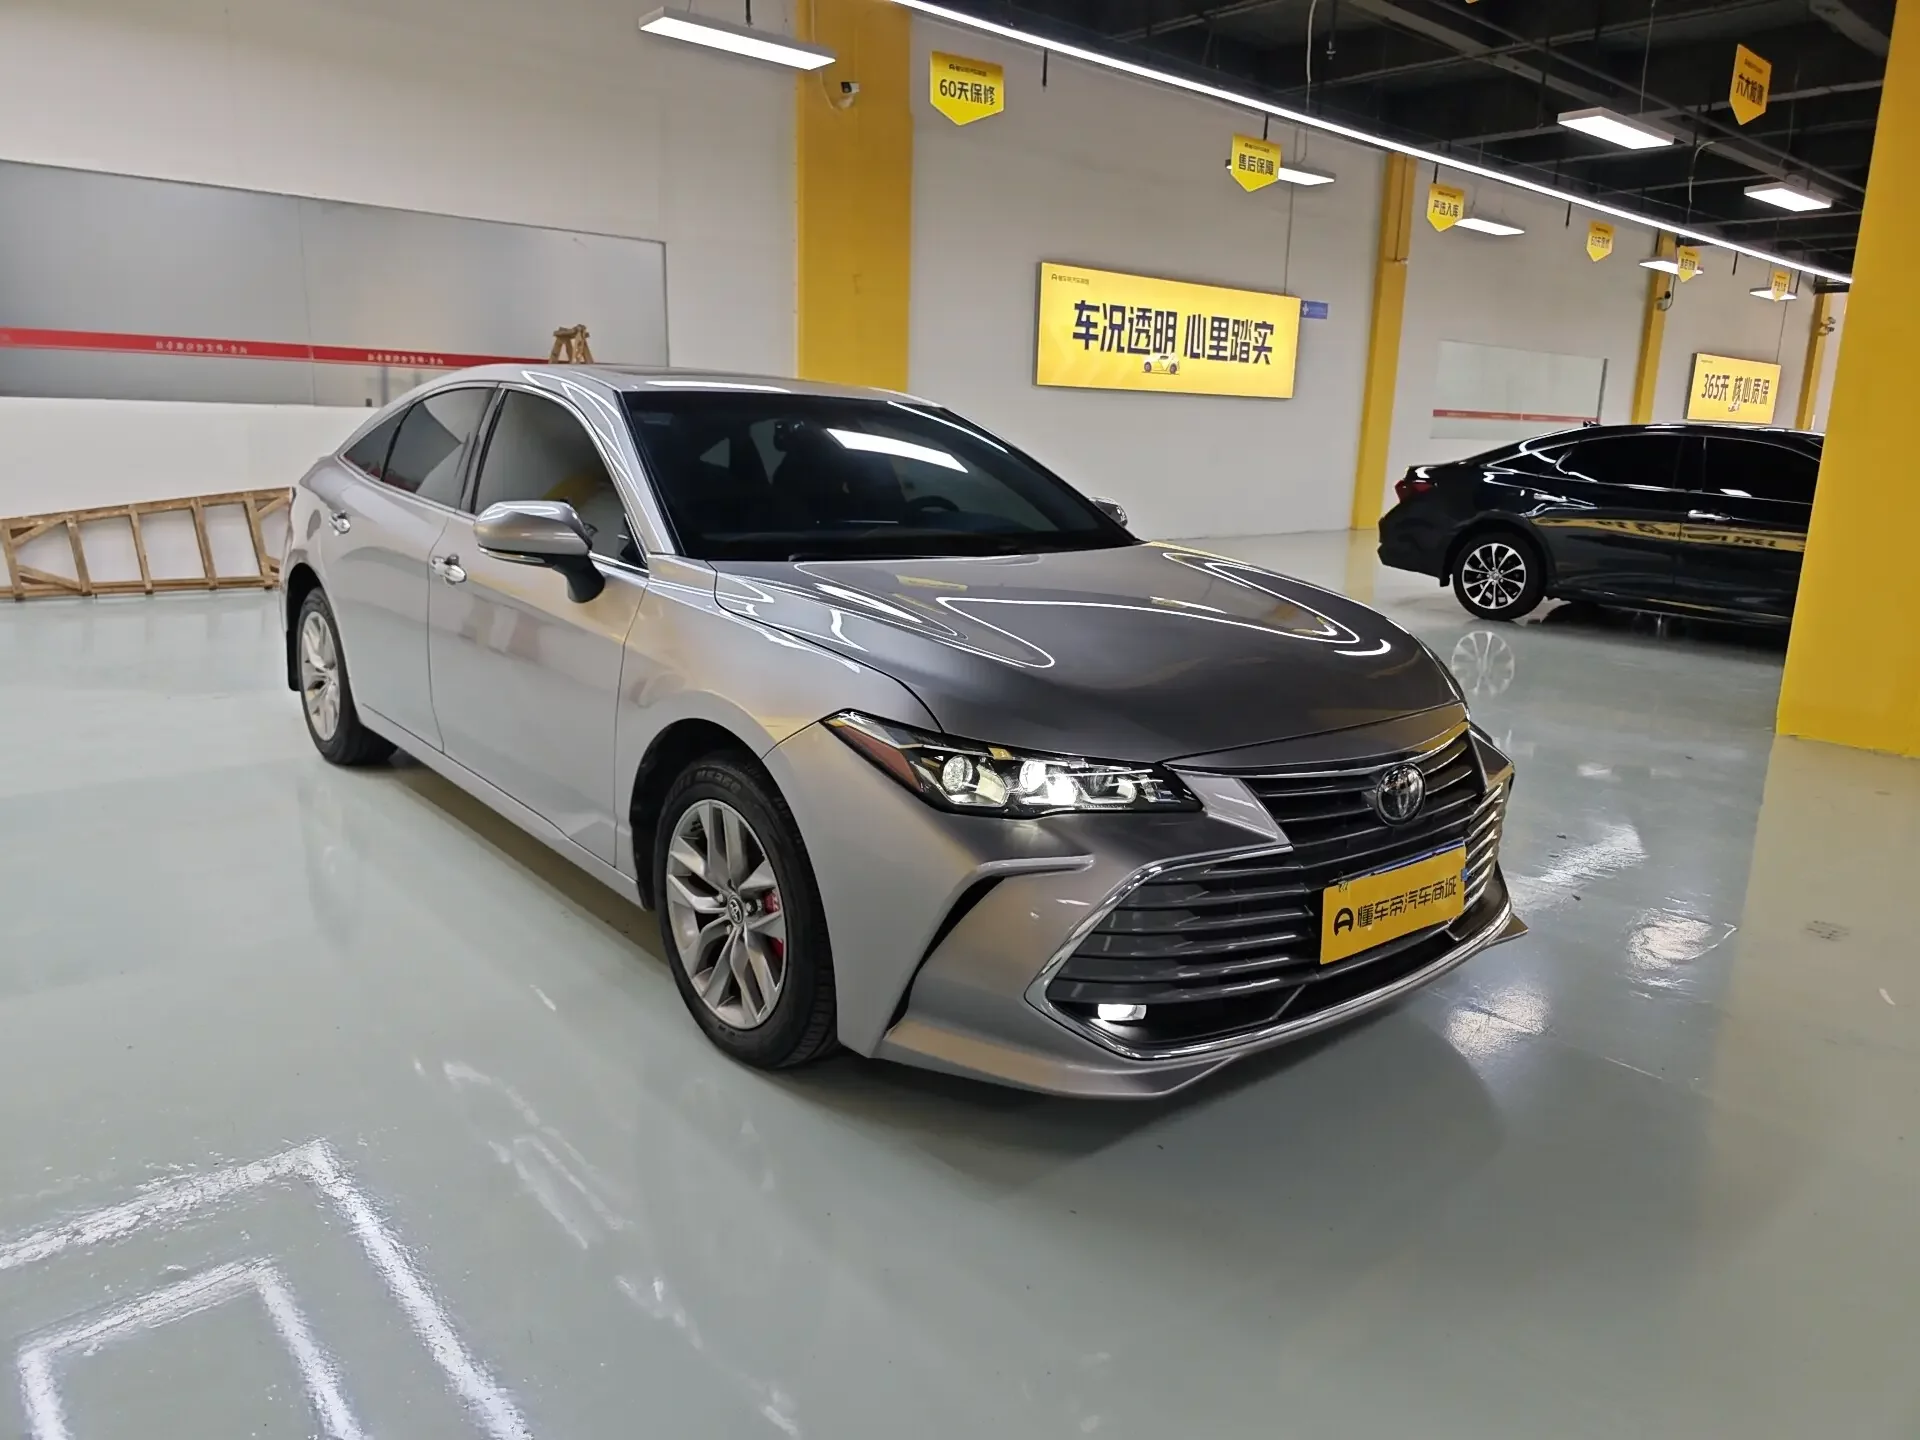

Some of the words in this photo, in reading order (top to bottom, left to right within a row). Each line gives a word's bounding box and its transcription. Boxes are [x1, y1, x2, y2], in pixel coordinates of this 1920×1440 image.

[940, 79, 995, 105] 60天保修
[1239, 153, 1274, 176] 售后保障
[1433, 200, 1459, 217] 严选入库
[1073, 300, 1178, 355] 车况透明
[1184, 314, 1274, 365] 心里踏实
[1701, 373, 1730, 401] 365天
[1732, 376, 1770, 405] 核心质保
[1357, 875, 1457, 928] 懂车帝汽车商城
